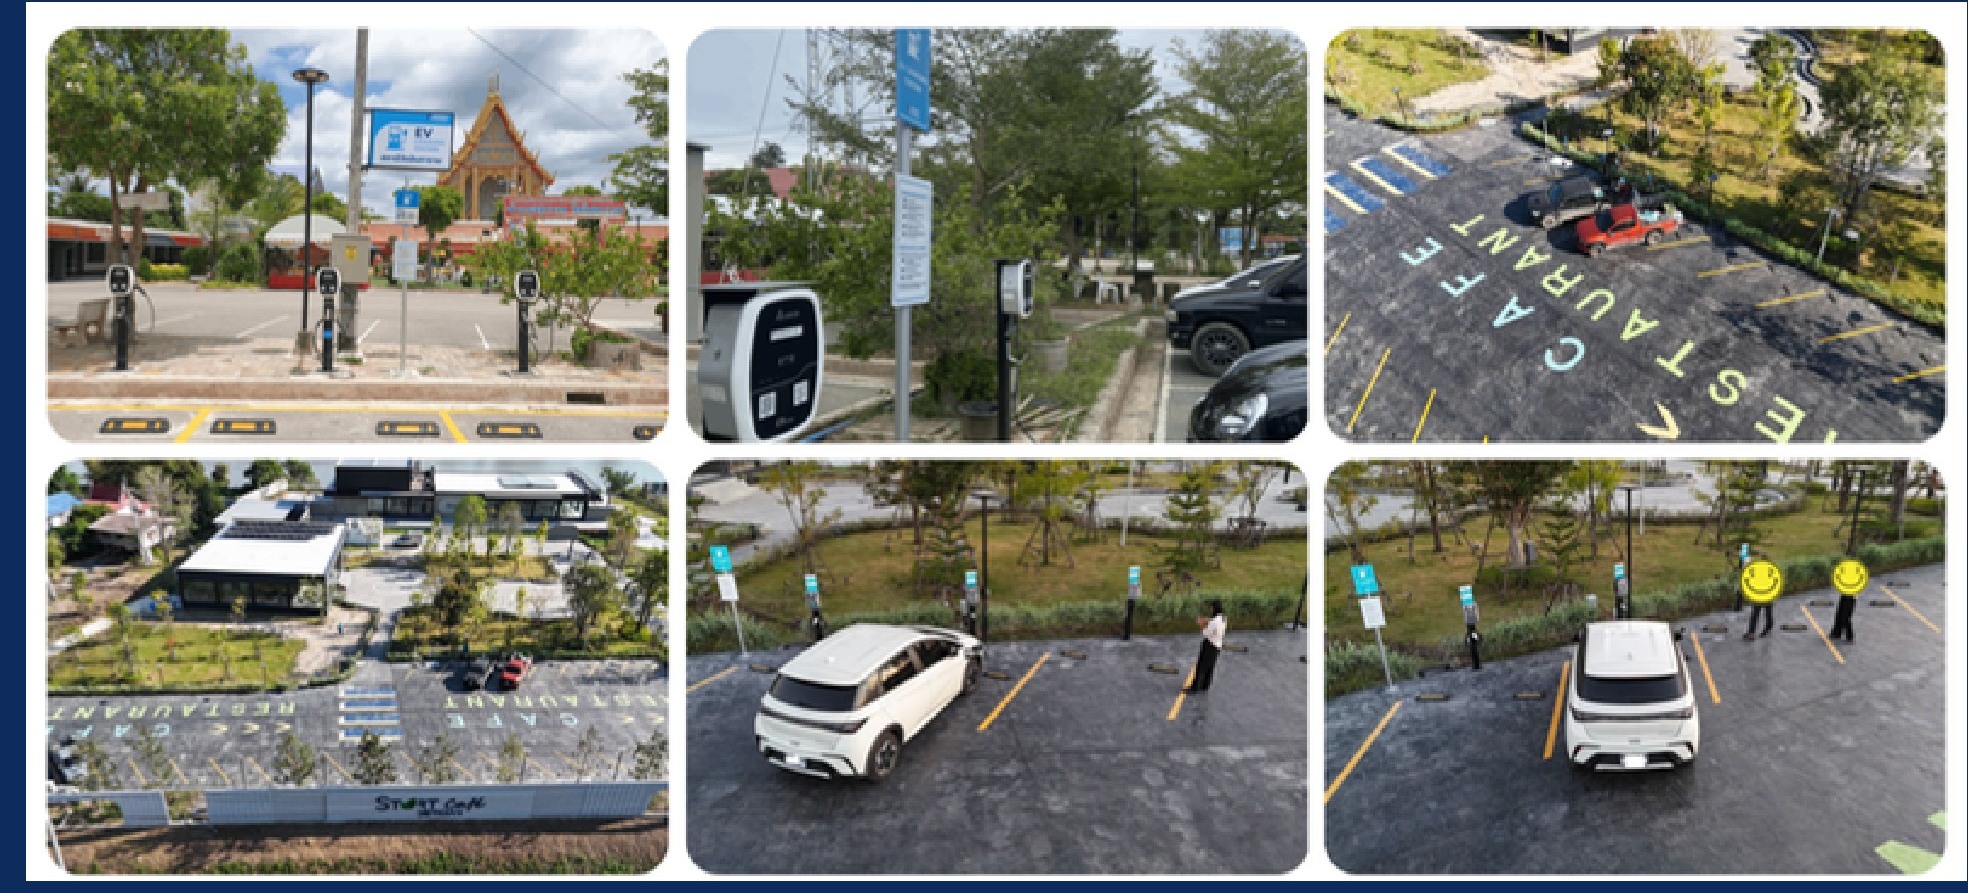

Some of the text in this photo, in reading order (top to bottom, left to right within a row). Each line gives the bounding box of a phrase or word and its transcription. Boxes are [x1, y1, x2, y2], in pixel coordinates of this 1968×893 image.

[414, 127, 434, 138] EV
[1399, 236, 1585, 371] CAFE
[447, 712, 578, 728] CAFE
